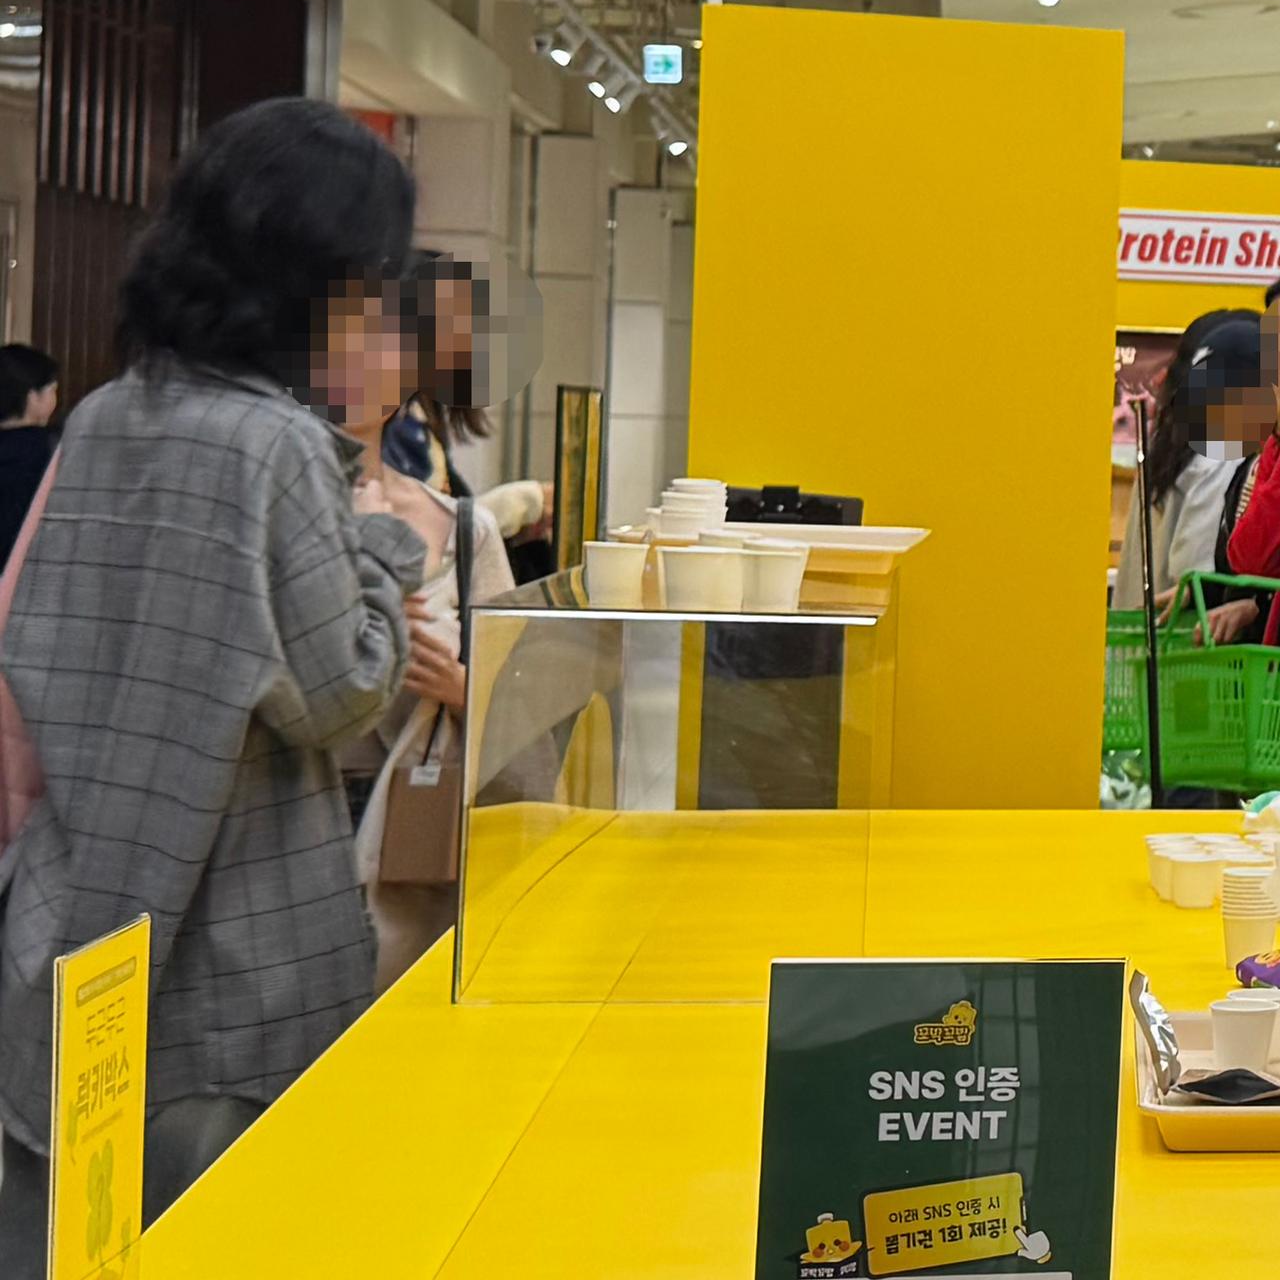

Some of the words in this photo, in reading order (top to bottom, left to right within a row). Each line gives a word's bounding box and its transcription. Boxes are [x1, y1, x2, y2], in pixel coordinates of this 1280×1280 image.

[1119, 228, 1229, 267] rotein
[868, 1070, 945, 1100] SNS
[954, 1066, 1020, 1102] 인증
[878, 1111, 1007, 1141] EVENT
[889, 1208, 919, 1224] 아래
[923, 1203, 951, 1221] SNS
[956, 1198, 982, 1217] 인증
[988, 1196, 1000, 1210] 시
[885, 1229, 934, 1255] 뽑기권
[938, 1224, 963, 1242] 1회
[968, 1218, 1008, 1239] 제공!
